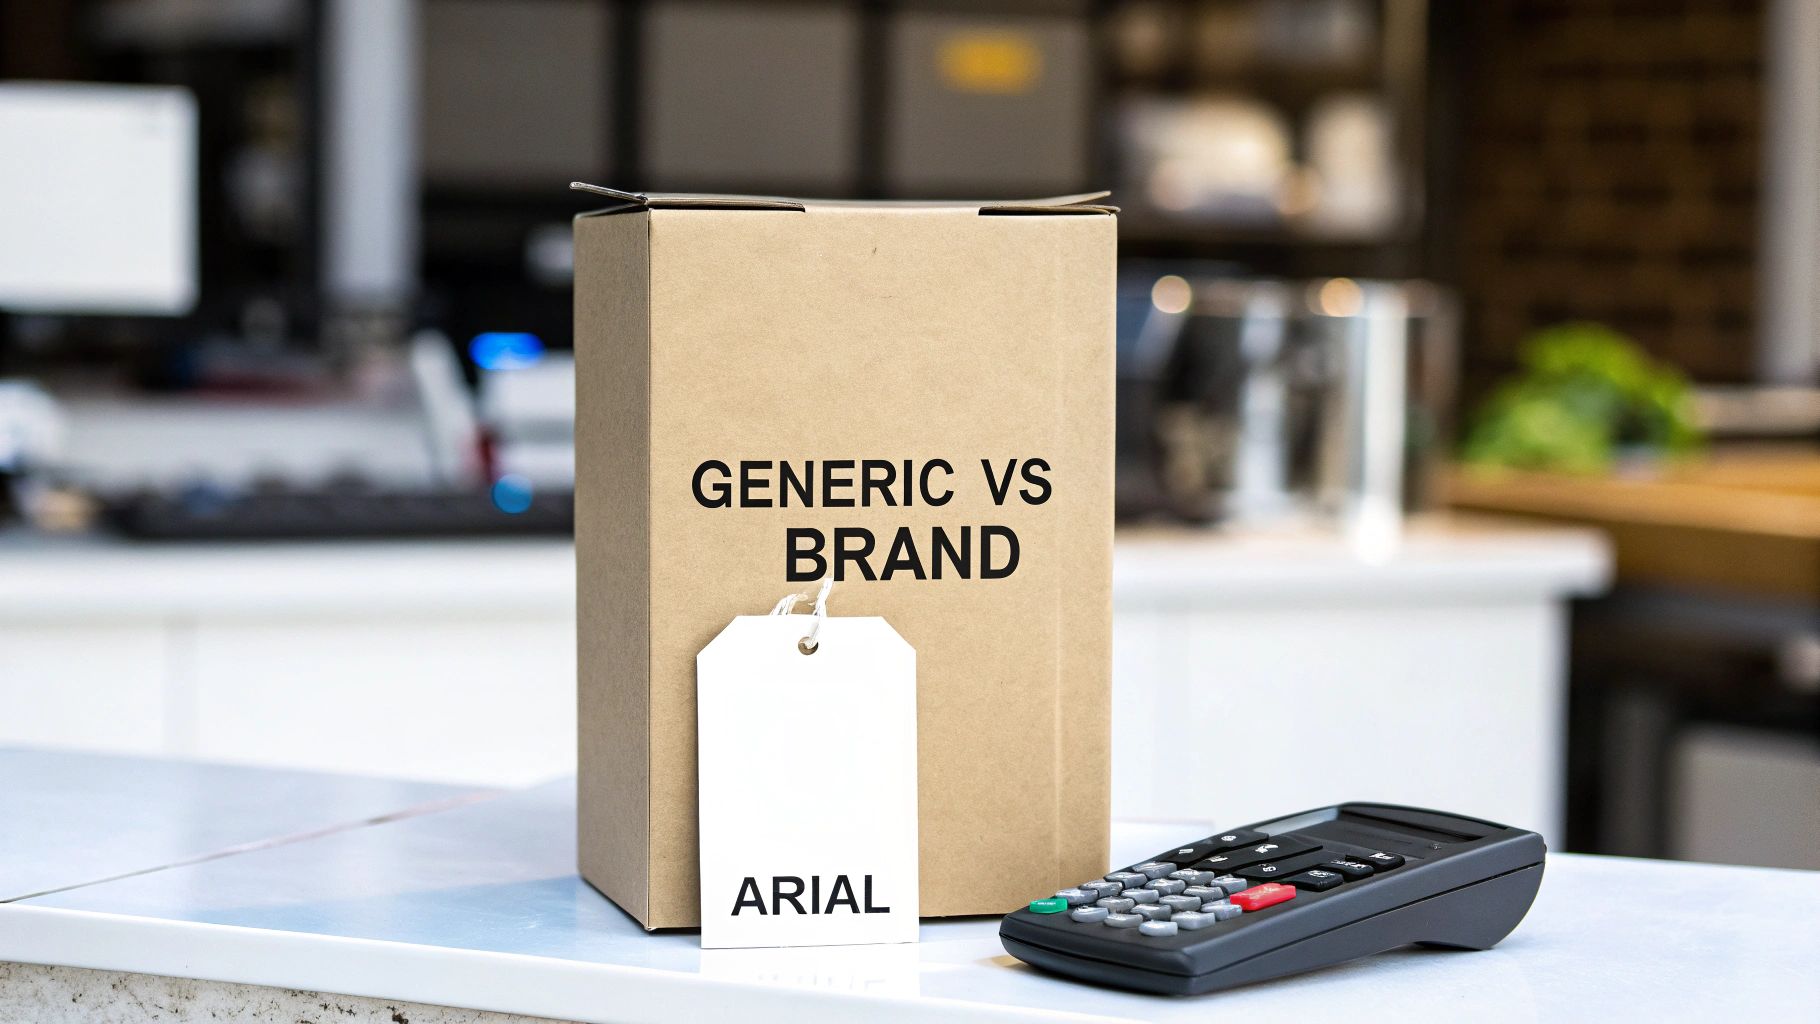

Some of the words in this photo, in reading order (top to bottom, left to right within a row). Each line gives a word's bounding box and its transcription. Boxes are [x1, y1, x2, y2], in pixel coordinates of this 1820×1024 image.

[692, 459, 954, 508] GENERIC
[981, 458, 1051, 505] VS
[787, 526, 1019, 581] BRAND
[731, 875, 889, 915] ARIAL
